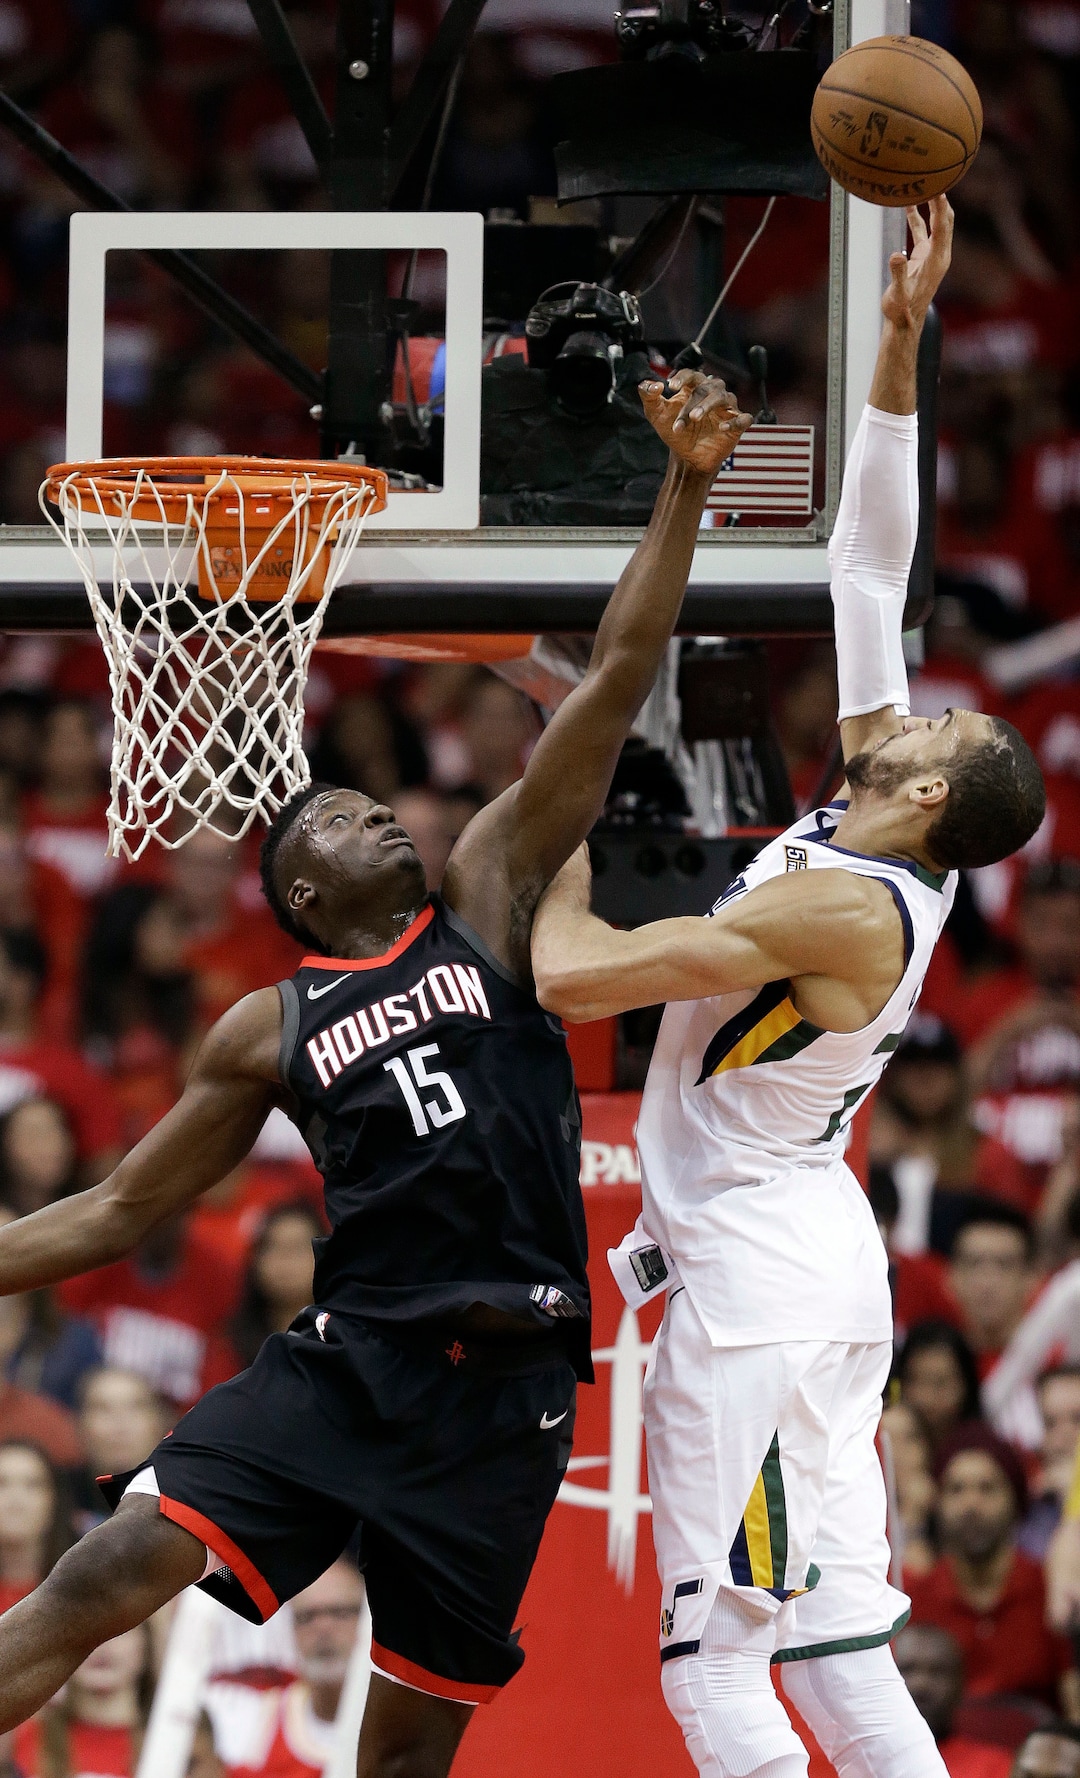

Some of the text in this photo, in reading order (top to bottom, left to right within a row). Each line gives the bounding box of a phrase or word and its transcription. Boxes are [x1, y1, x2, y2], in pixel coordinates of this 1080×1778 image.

[212, 559, 294, 579] SPADING
[786, 848, 806, 861] 5
[306, 963, 493, 1090] HOUSTON
[383, 1042, 467, 1137] 15
